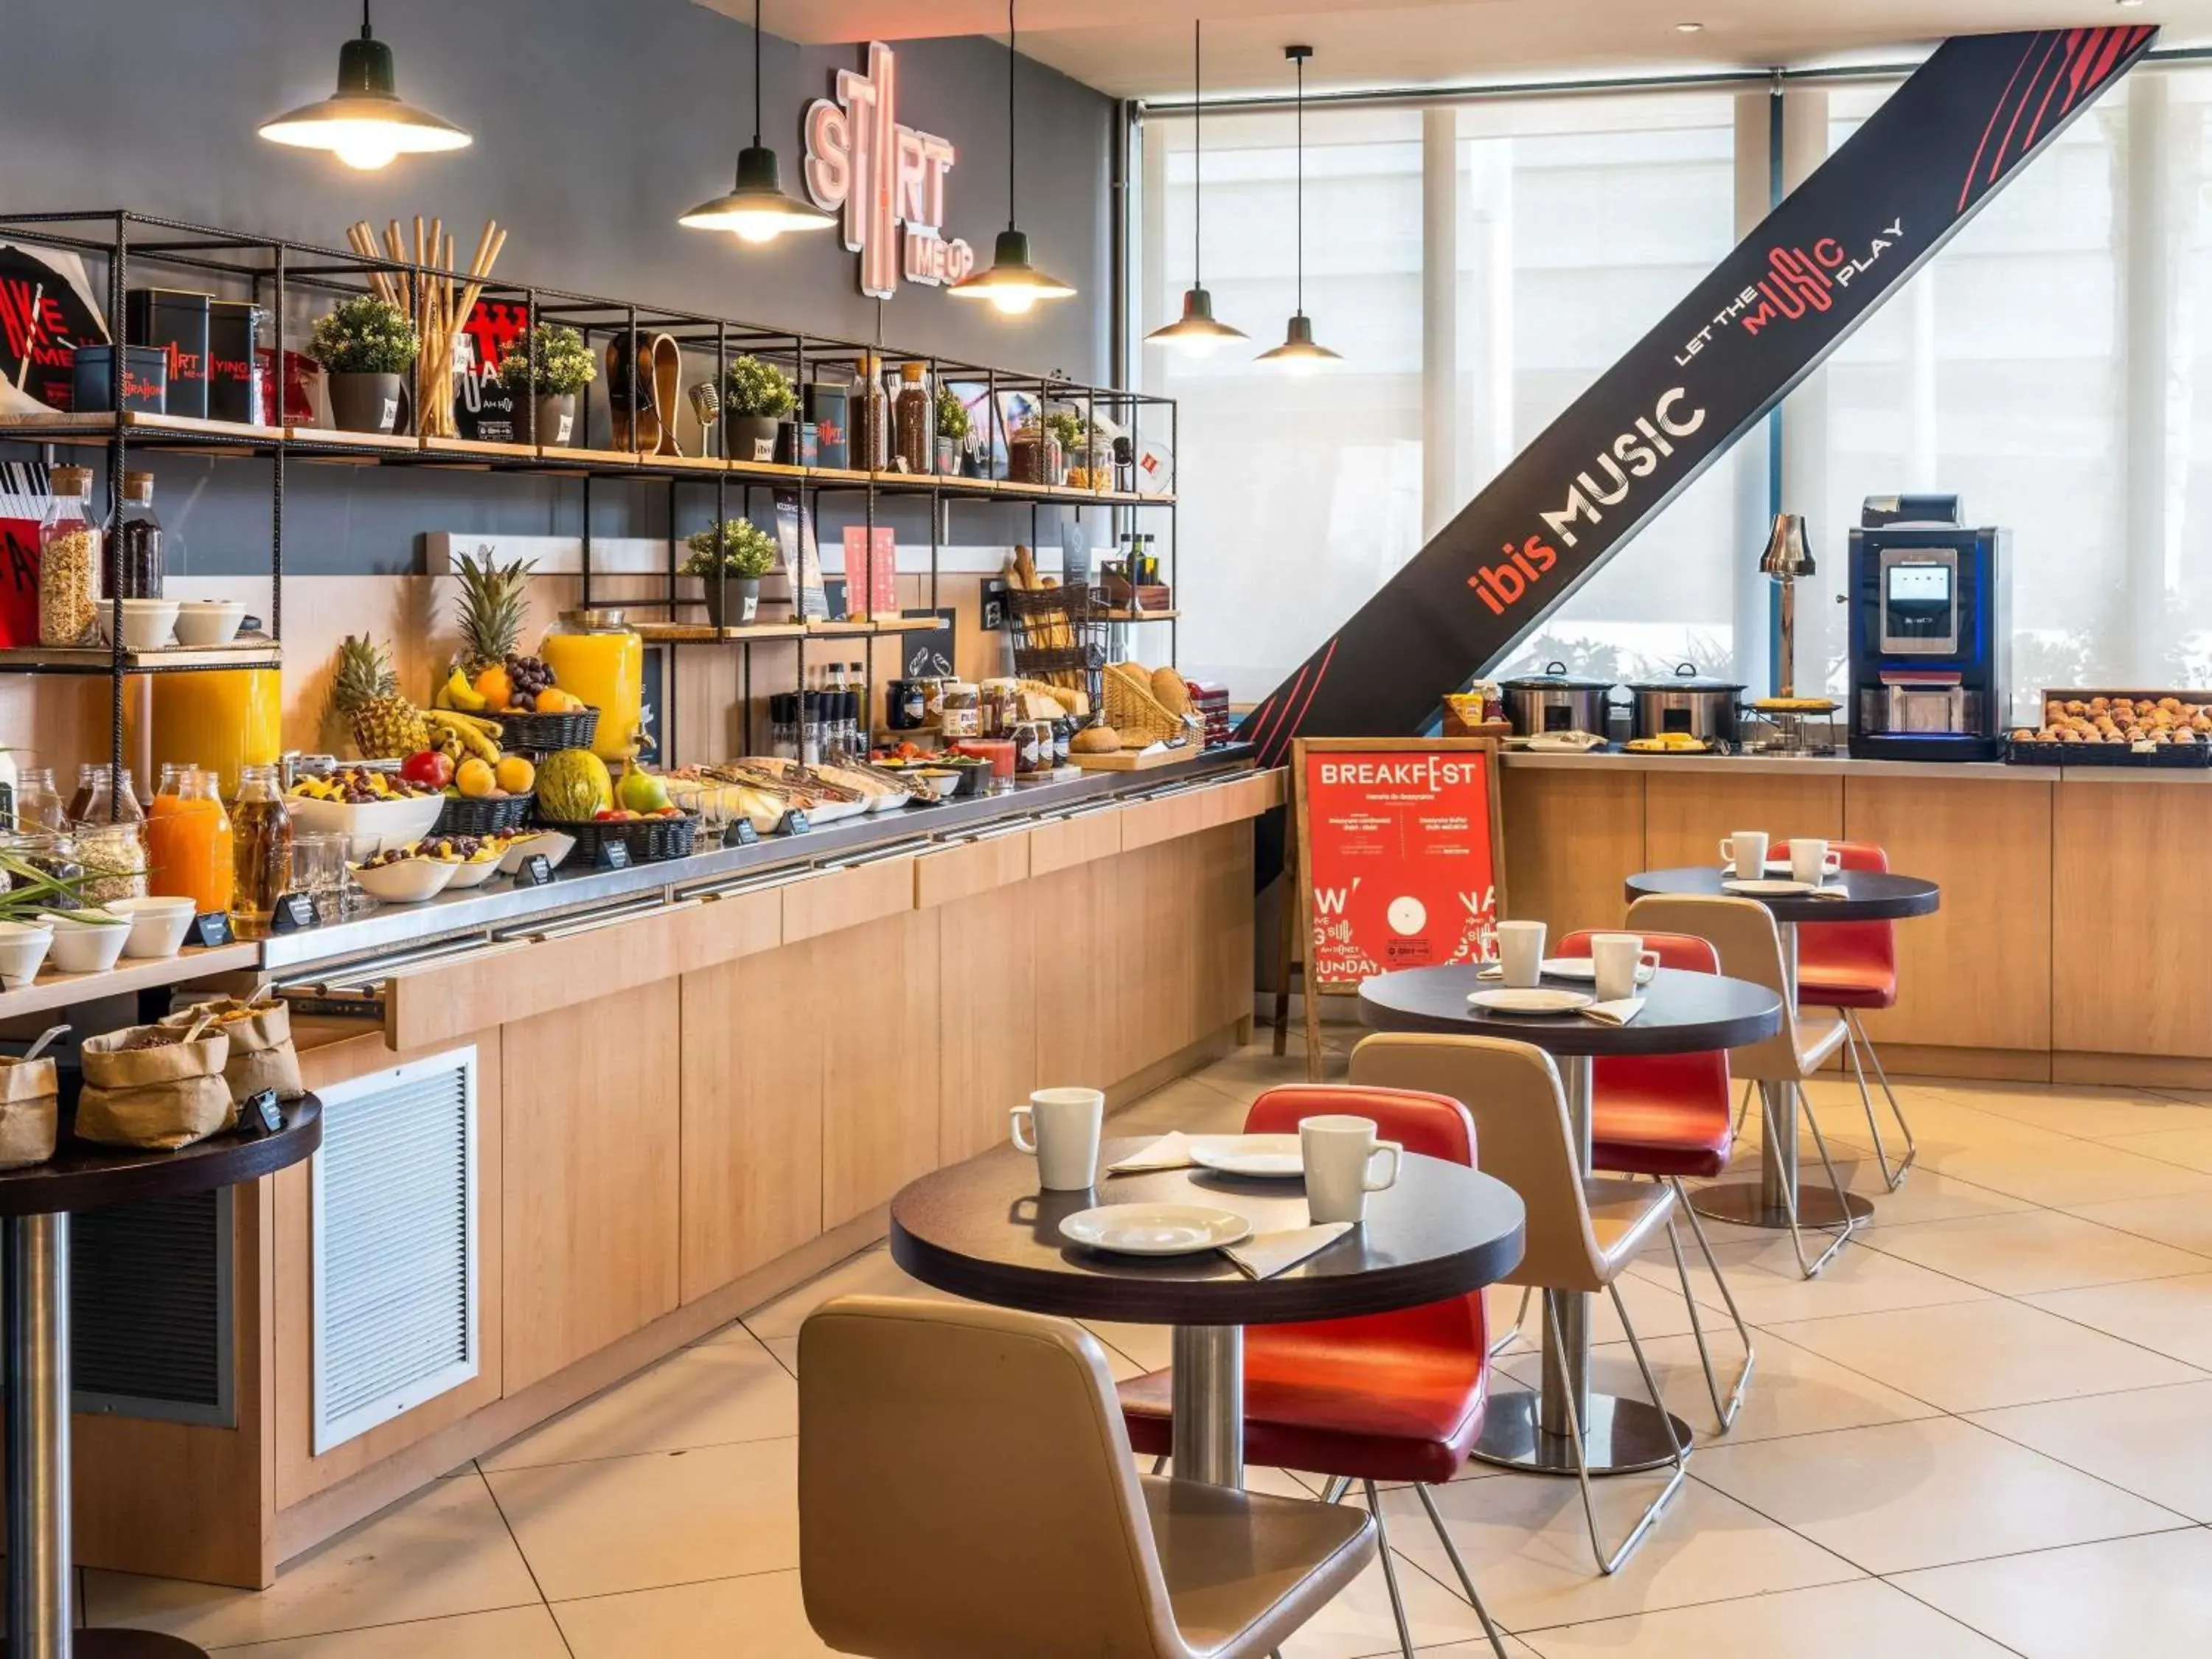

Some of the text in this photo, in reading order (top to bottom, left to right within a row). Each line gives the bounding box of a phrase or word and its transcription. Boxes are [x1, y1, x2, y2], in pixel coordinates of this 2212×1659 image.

[911, 236, 946, 281] ME
[1674, 217, 1905, 366] LET THE MUSIC PLAY
[1467, 386, 1706, 616] ibis MUSIC
[1321, 756, 1475, 792] BREAKFEST
